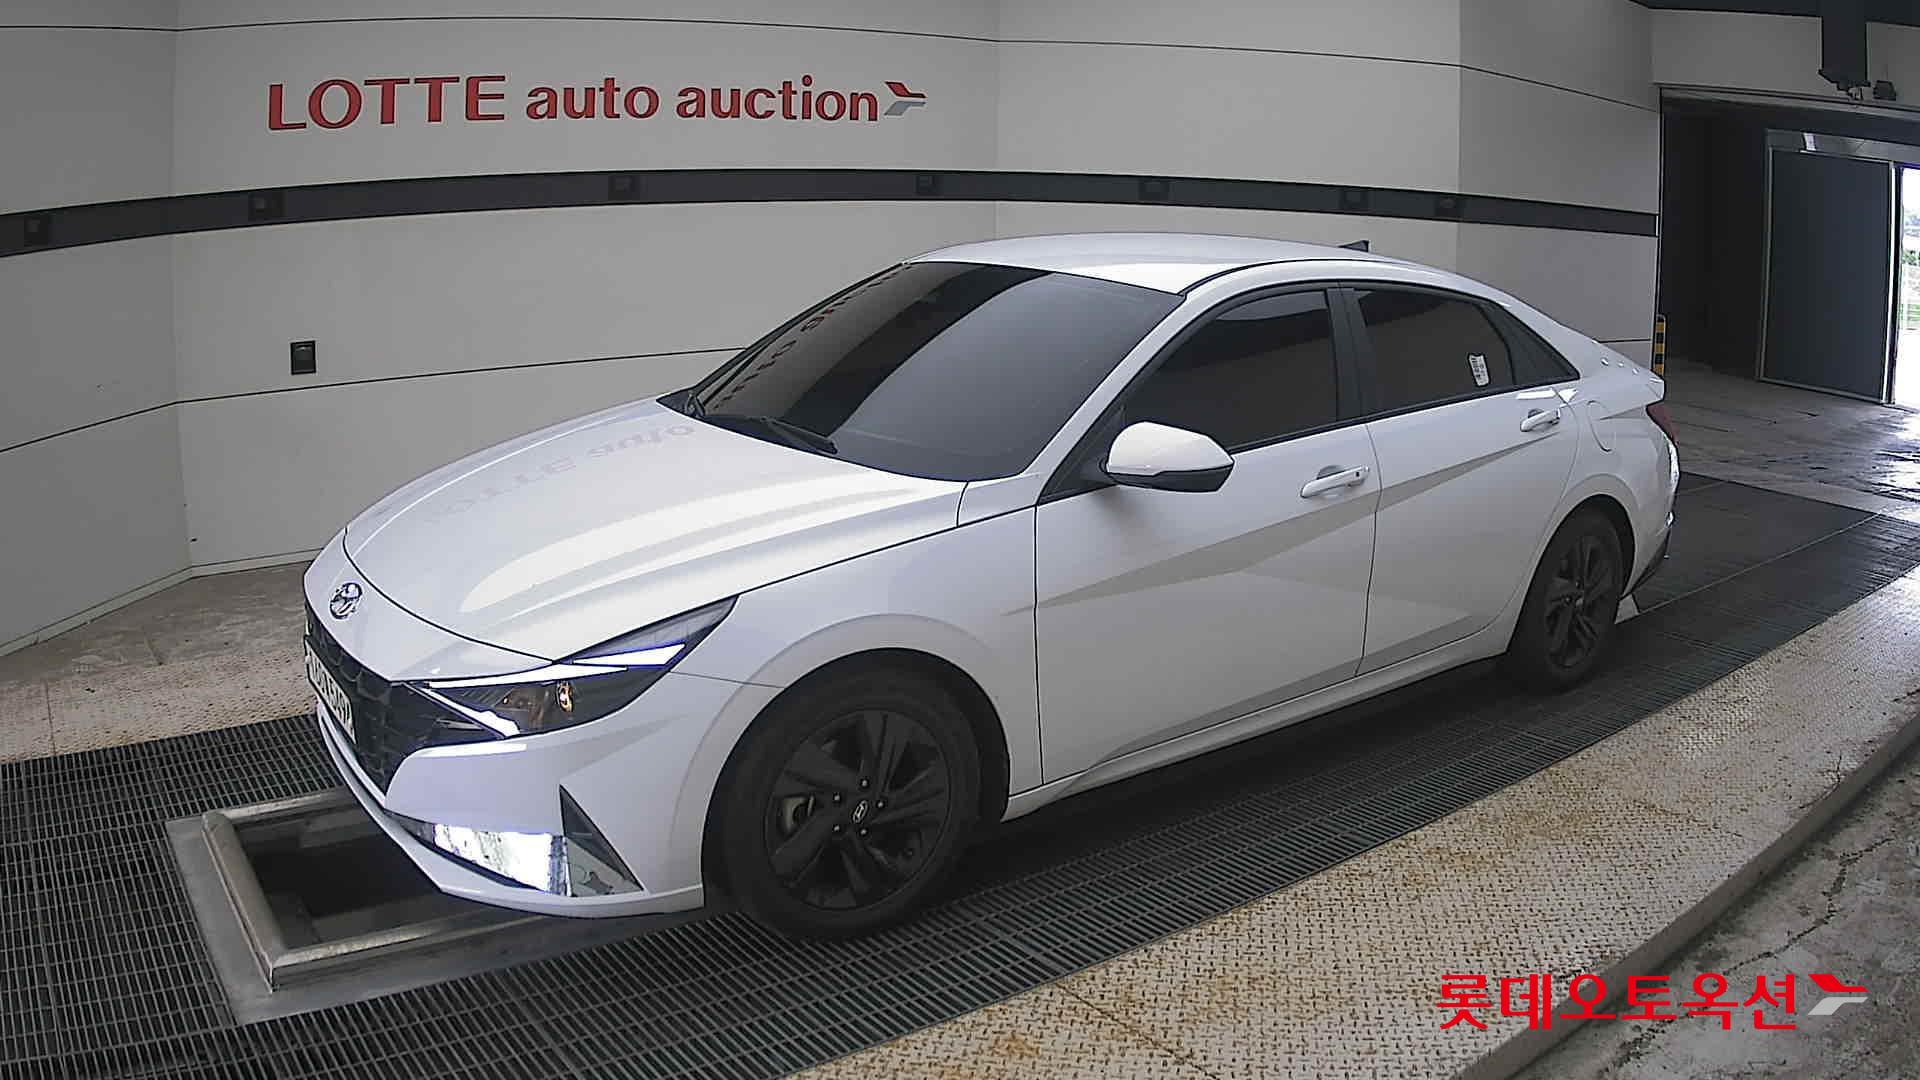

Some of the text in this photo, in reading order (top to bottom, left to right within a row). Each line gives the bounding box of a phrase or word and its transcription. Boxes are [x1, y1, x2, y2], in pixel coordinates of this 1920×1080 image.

[268, 74, 878, 131] LOTTE auto auction
